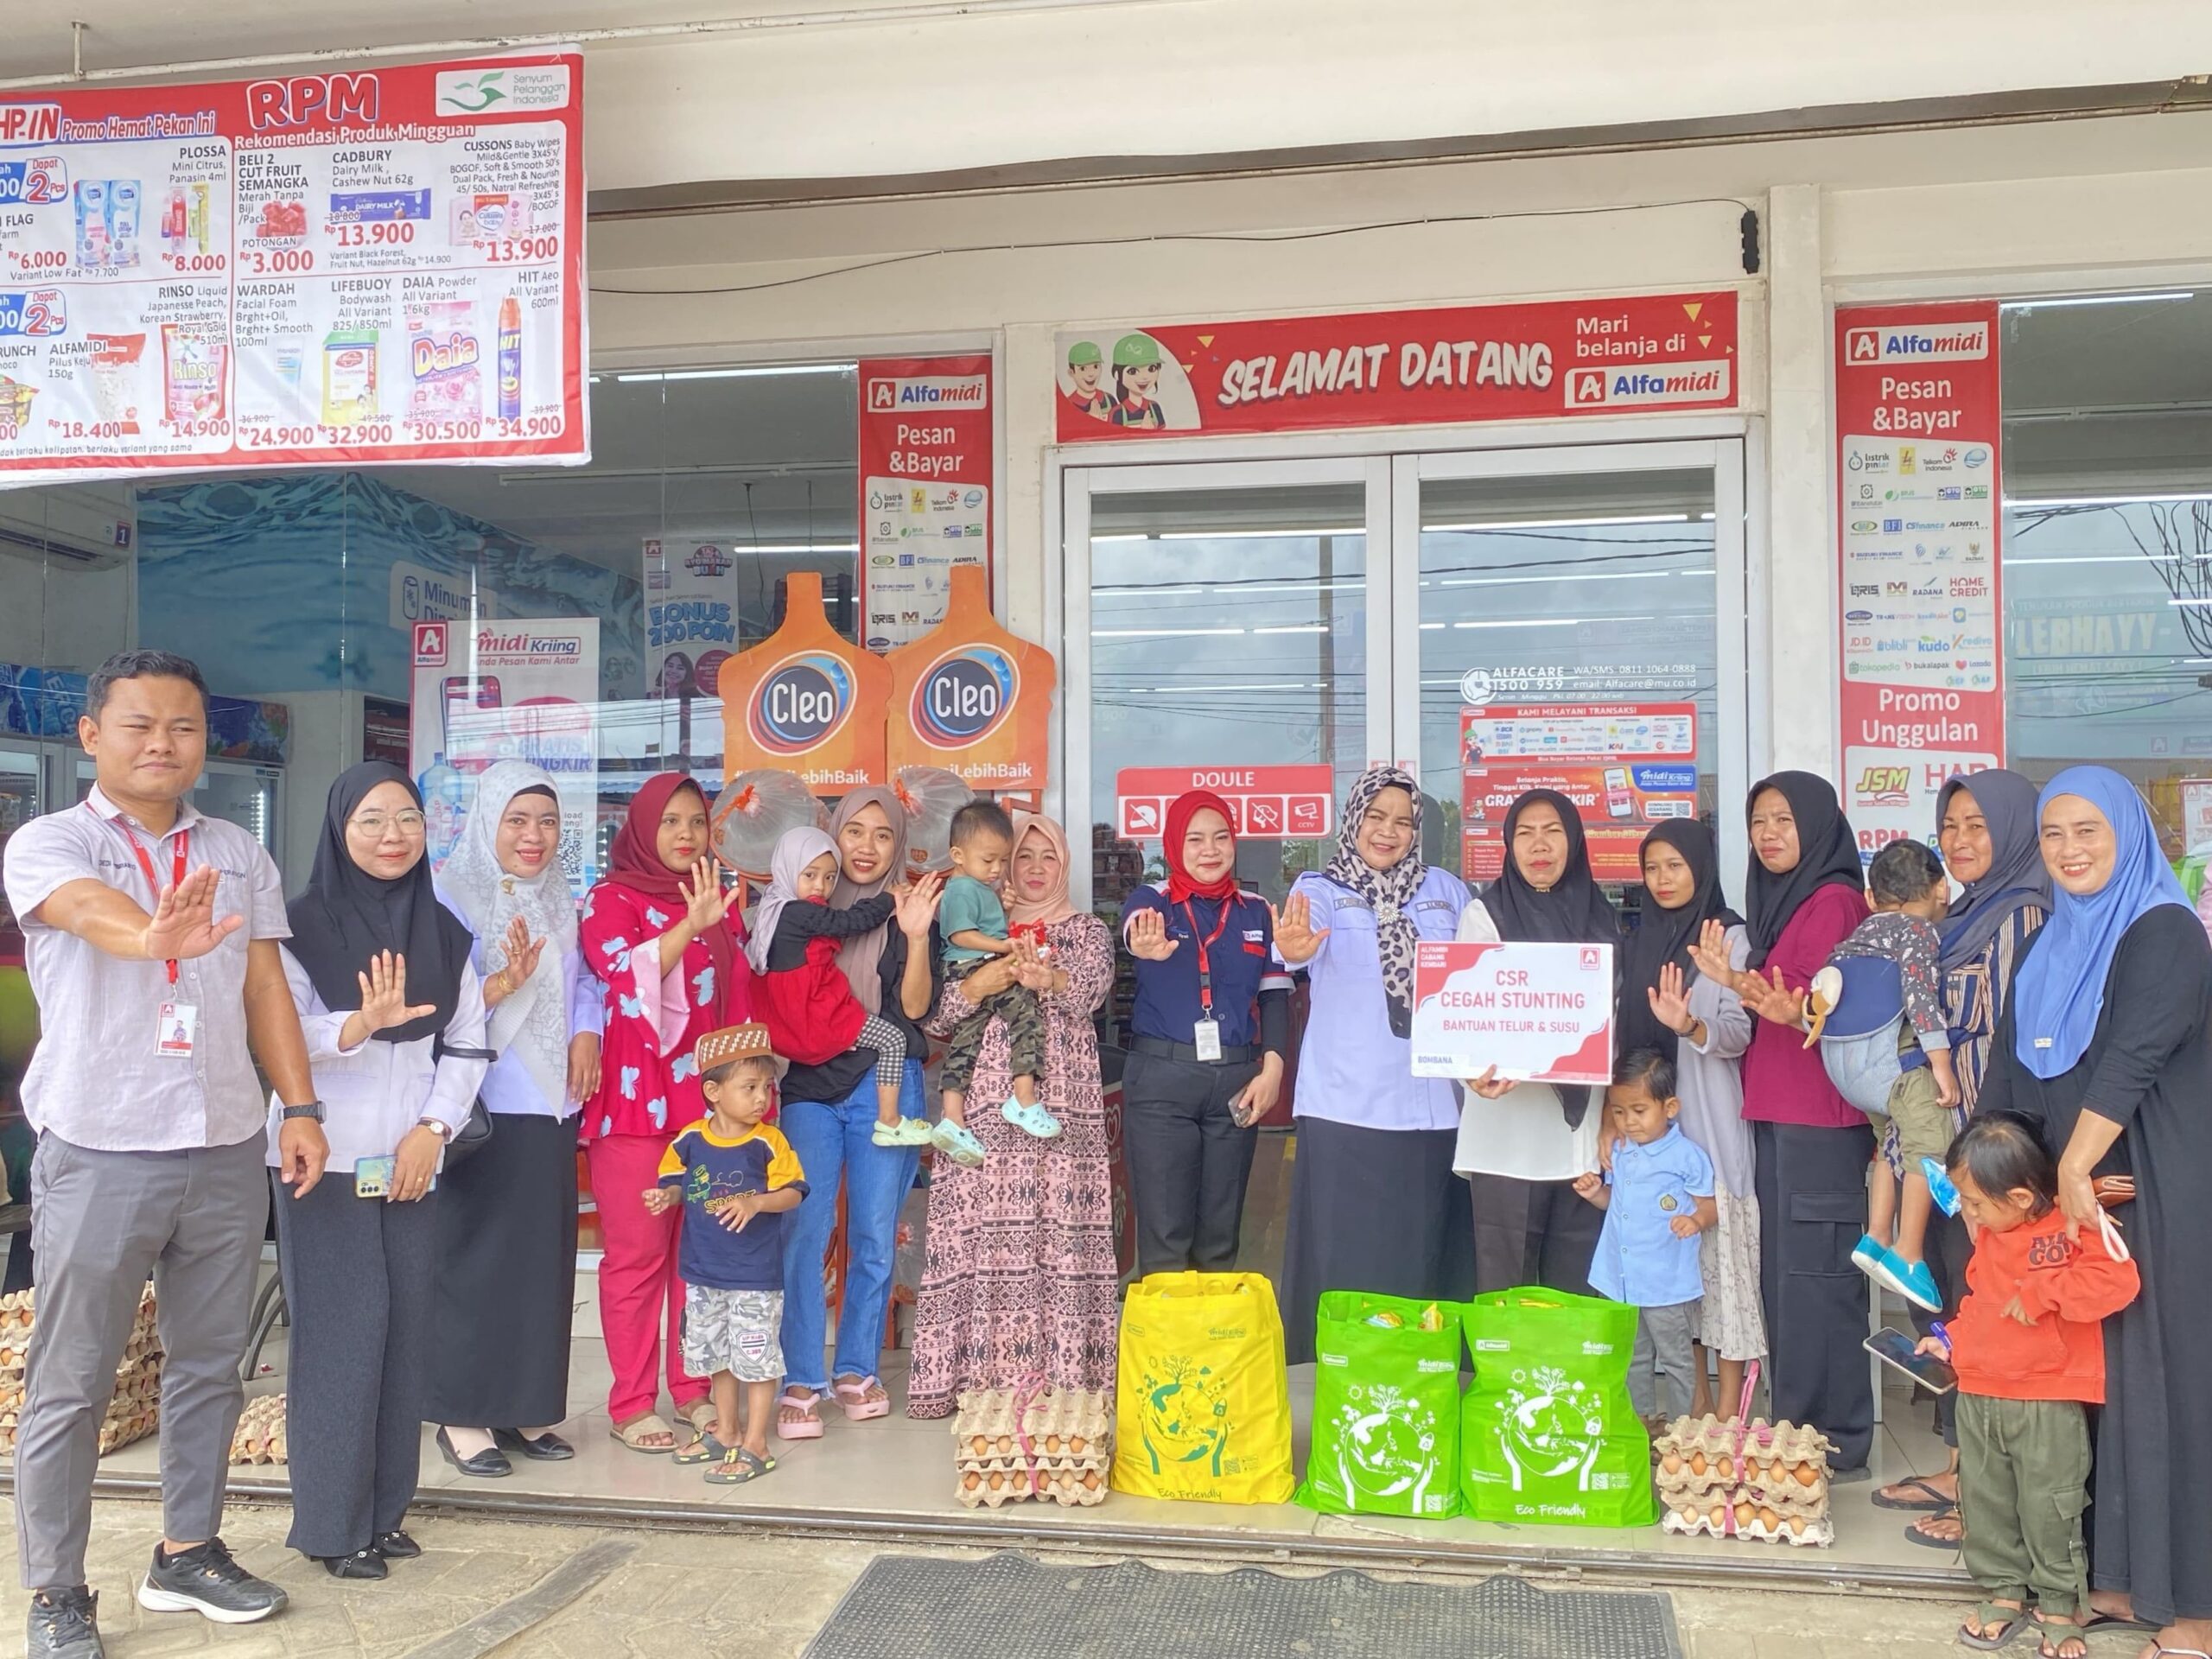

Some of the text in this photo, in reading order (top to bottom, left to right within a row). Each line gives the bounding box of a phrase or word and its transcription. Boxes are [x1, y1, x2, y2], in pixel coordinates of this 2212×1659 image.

[513, 73, 552, 84] Senyum
[513, 84, 565, 94] Pelanggan
[246, 73, 378, 130] RPM
[513, 94, 559, 105] Indonesia
[61, 119, 105, 141] Promo
[108, 116, 151, 138] Hemat
[155, 113, 195, 136] Pekan
[196, 111, 214, 134] Ini
[234, 124, 474, 149] Rekomendasi Produk Mingguan
[464, 137, 560, 151] CUSSONS Baby Wipes
[179, 145, 226, 159] PLOSSA
[333, 149, 391, 163] CADBURY
[33, 159, 58, 170] Dapat
[239, 154, 274, 166] BELI 2
[239, 164, 302, 178] CUT FRUIT
[333, 163, 383, 176] Dairy Milk
[169, 172, 226, 184] Panasin 4ml
[238, 177, 308, 191] SEMANGKA
[333, 174, 413, 188] Cashew Nut 62g
[28, 172, 66, 202] 2 Pcs
[238, 190, 303, 202] Merah Tanpa
[238, 202, 253, 214] Biji
[6, 213, 34, 226] FLAG
[325, 222, 415, 246] Rp 13.900
[242, 238, 296, 248] POTONGAN
[473, 236, 559, 262] Rp 13.900
[21, 251, 67, 269] 6.000
[175, 254, 226, 271] 8.000
[240, 250, 314, 273] Rp 3.000
[403, 276, 477, 289] DAIA Powder
[518, 271, 559, 283] HIT Aeo
[159, 285, 227, 298] RINSO Liquid
[237, 283, 295, 296] WARDAH
[332, 278, 391, 292] LIFEBUOY
[509, 283, 559, 296] All Variant
[33, 292, 57, 302] Dapat
[340, 294, 391, 305] Bodywash
[402, 290, 456, 302] All Variant
[237, 298, 297, 309] Facial Foam
[339, 307, 391, 317] All Variant
[1576, 315, 1629, 335] Mari
[50, 341, 106, 355] ALFAMIDI
[236, 337, 268, 347] 100ml
[1576, 334, 1686, 359] belanja di
[1886, 332, 1984, 354] Alfamidi
[412, 333, 479, 379] Daia
[1217, 340, 1554, 406] SELAMAT DATANG
[1613, 371, 1720, 396] Alfamidi
[1881, 377, 1952, 401] Pesan
[901, 383, 982, 404] Alfamidi
[498, 416, 561, 437] 34.900
[1872, 406, 1962, 435] &Bayar
[63, 422, 121, 438] 18.400
[172, 420, 230, 437] 14.900
[328, 425, 392, 444] 32.900
[414, 422, 480, 441] 30.500
[897, 424, 956, 446] Pesan
[251, 427, 314, 446] 24.900
[889, 450, 964, 478] &Bayar
[1949, 577, 1984, 587] HOME
[424, 580, 487, 618] Minumn
[1949, 588, 1988, 597] CREDIT
[649, 601, 731, 626] BONUS
[687, 621, 735, 644] POIN
[530, 639, 576, 654] Kriing
[1918, 640, 1950, 652] kudo
[477, 656, 580, 666] nda Pesan Kami Antar
[1493, 666, 1565, 678] ALFACARE
[1573, 665, 1614, 675] WA/SMS
[1536, 680, 1563, 690] 959
[772, 683, 834, 724] Cleo
[935, 677, 996, 718] Cleo
[1879, 688, 1961, 712] Promo
[1541, 708, 1586, 716] MELAYANI
[1862, 715, 1978, 748] Unggulan
[1192, 772, 1255, 788] DOULE
[1855, 766, 1911, 793] JSM
[1496, 970, 1529, 986] CSR
[1440, 991, 1585, 1009] CEGAH STUNTING
[1443, 1020, 1580, 1033] BANTUAN TELUR & SUSU
[1418, 1056, 1453, 1065] BOMBANA
[1158, 1488, 1222, 1501] Eco Friendly
[1515, 1503, 1586, 1518] Eco Friendly
